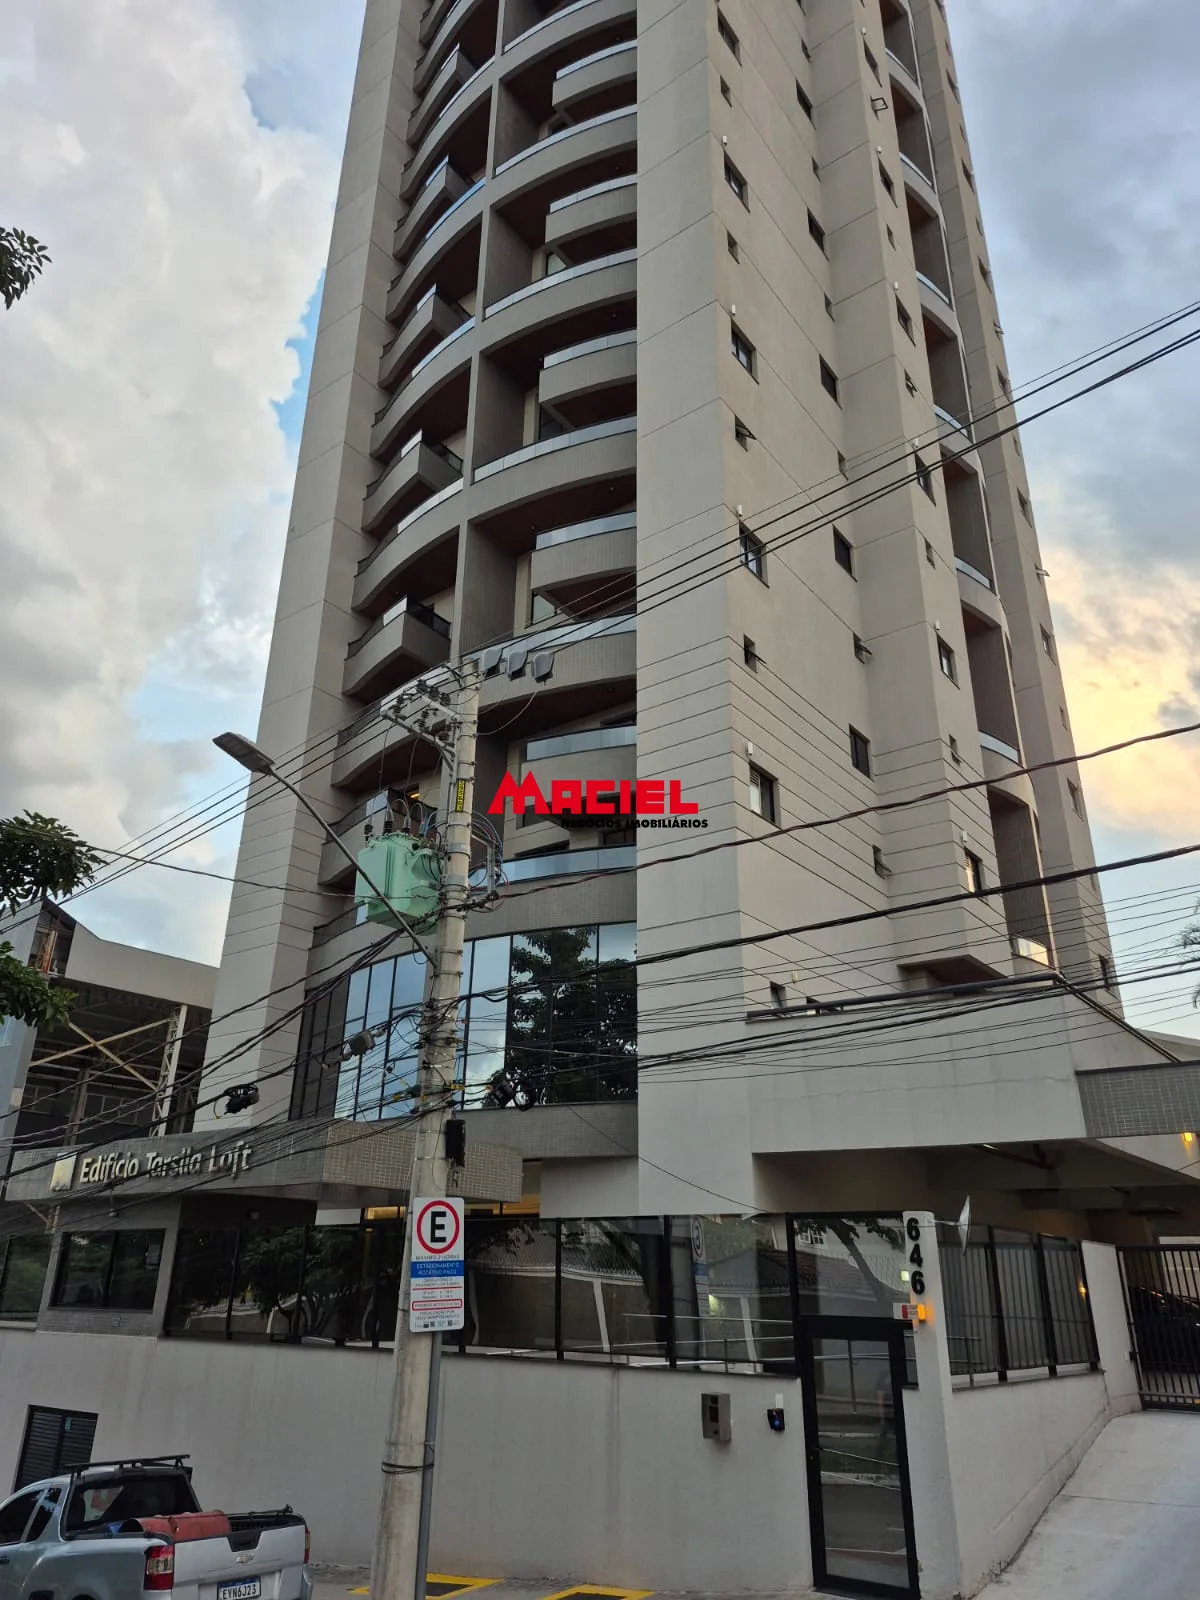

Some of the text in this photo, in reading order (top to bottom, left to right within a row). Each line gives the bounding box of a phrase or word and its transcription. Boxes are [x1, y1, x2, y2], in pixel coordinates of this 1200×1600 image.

[79, 1151, 140, 1184] Edifício
[208, 1140, 252, 1178] Loft
[430, 1211, 447, 1243] E
[906, 1217, 926, 1295] 646
[222, 1583, 257, 1600] EYN6J23
